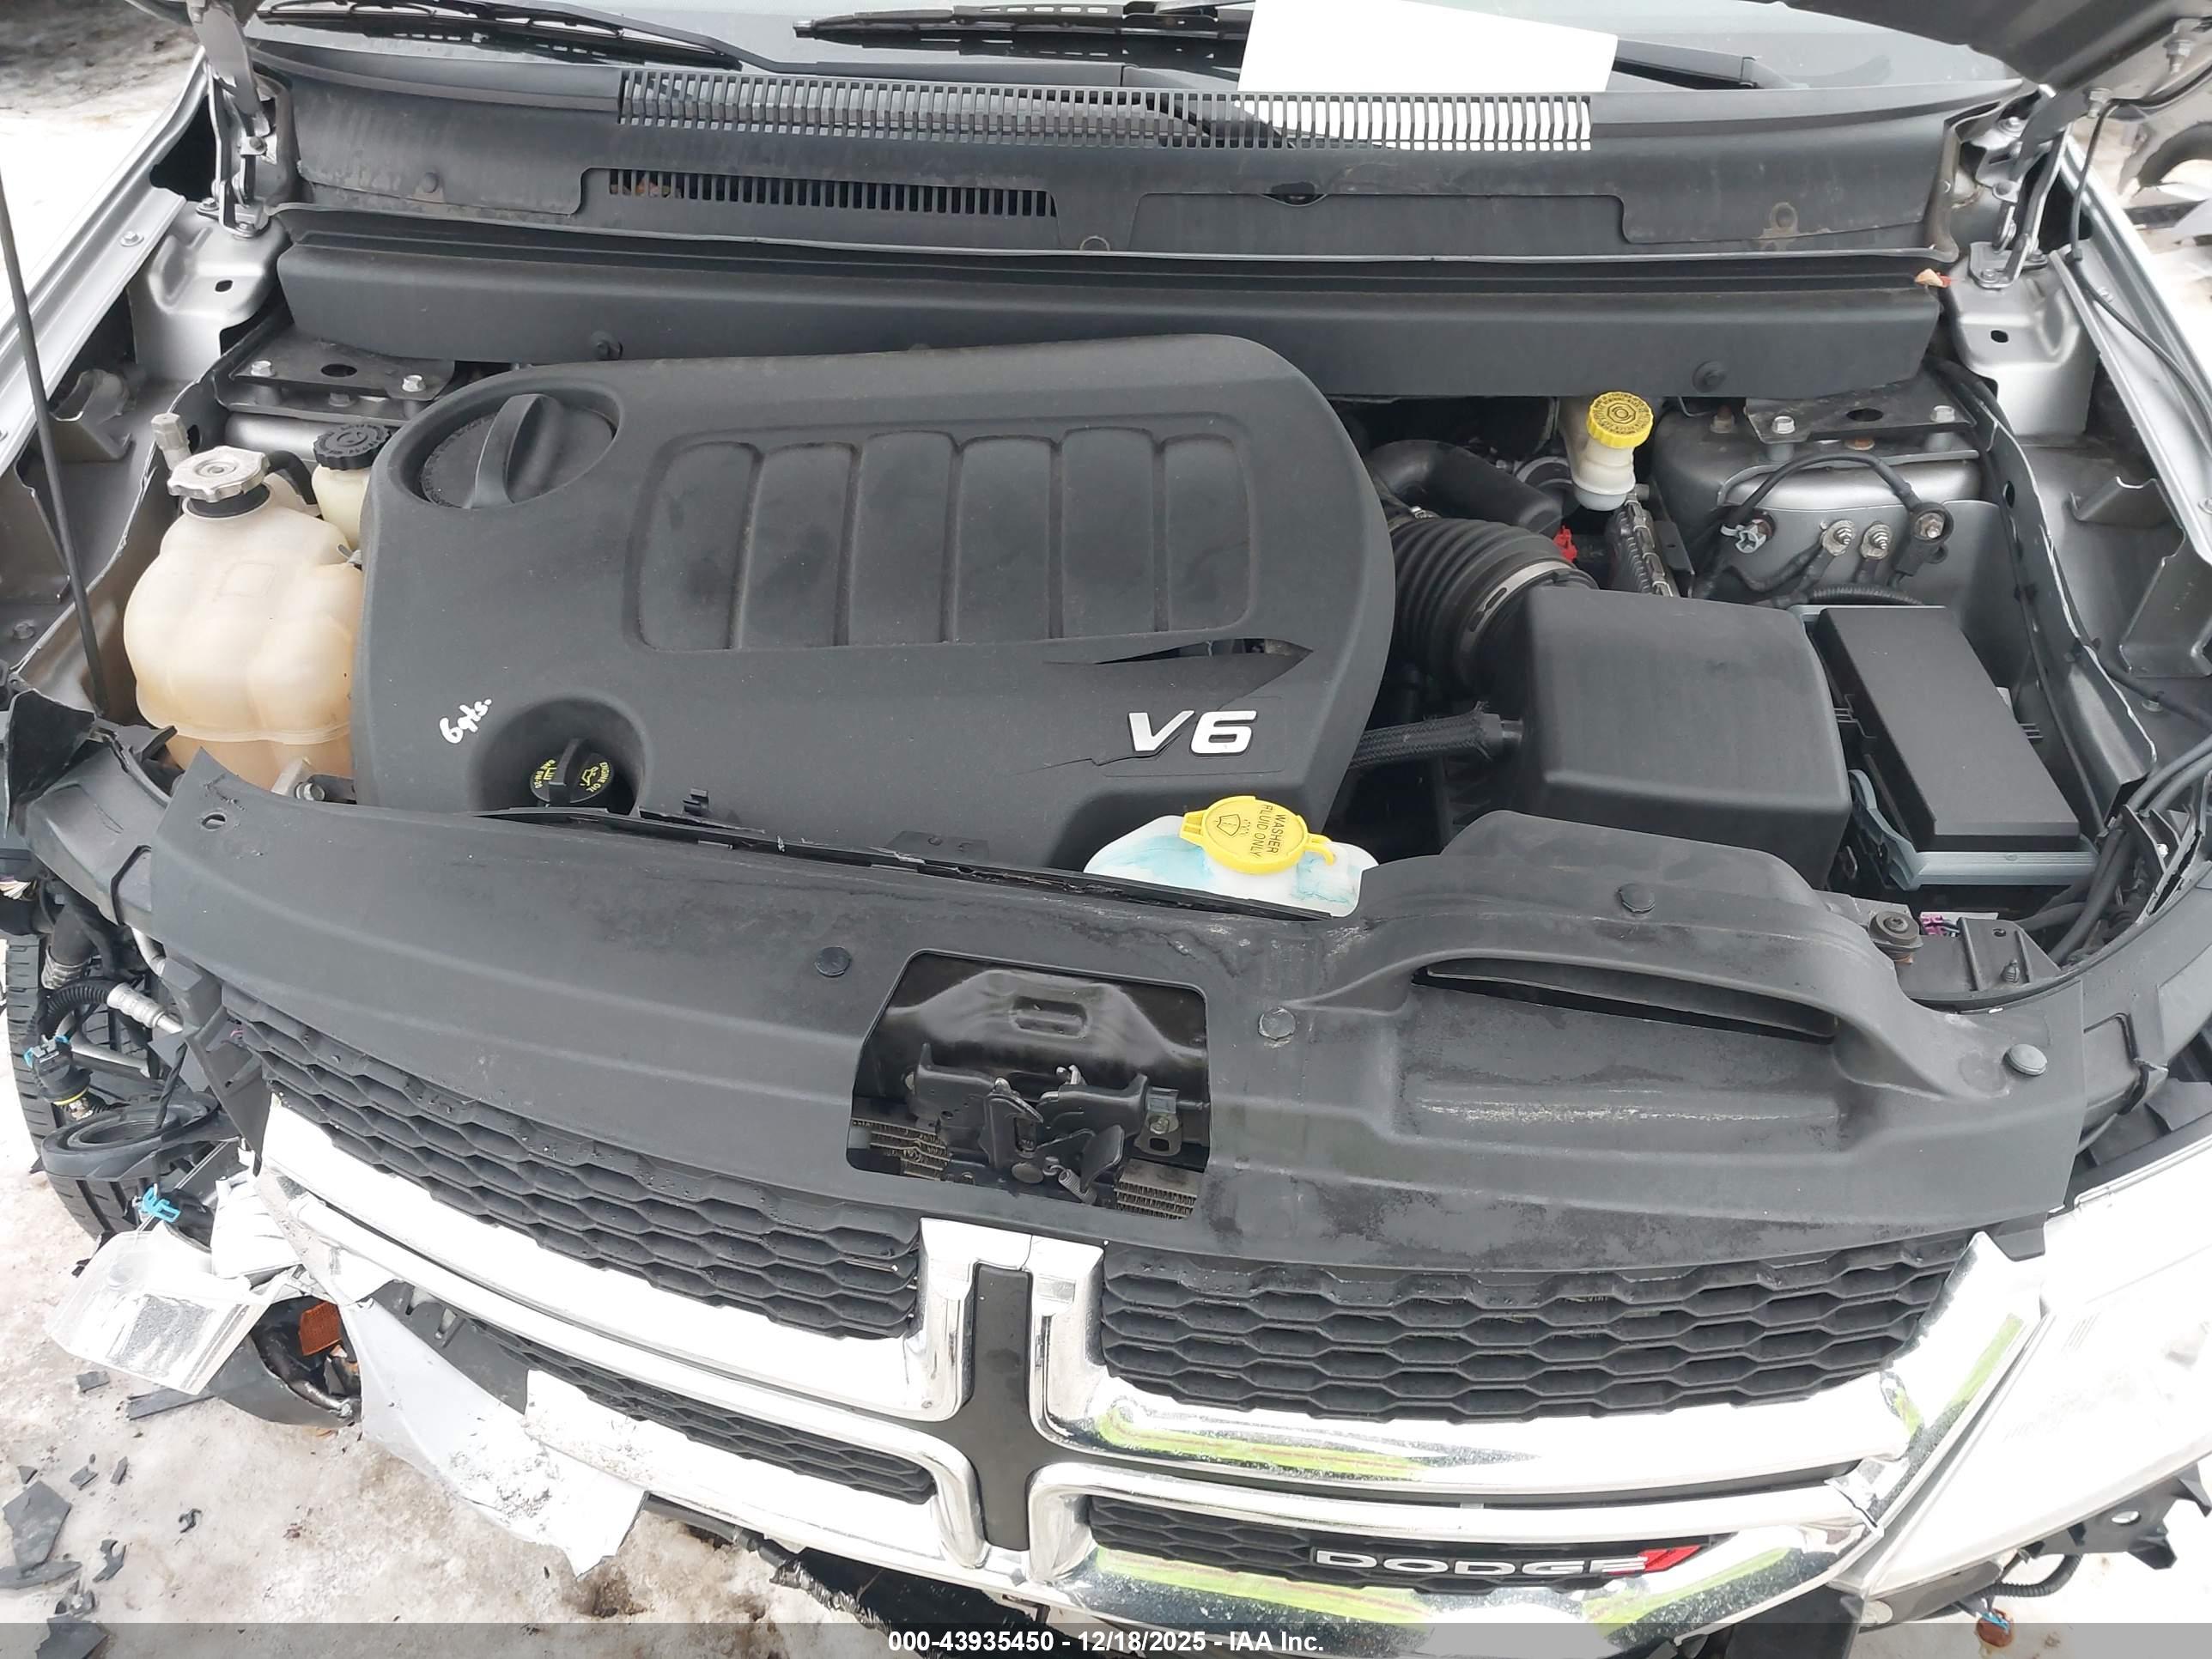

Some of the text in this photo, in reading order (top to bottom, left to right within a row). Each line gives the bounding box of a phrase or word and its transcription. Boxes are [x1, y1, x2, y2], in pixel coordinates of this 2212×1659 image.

[1128, 709, 1257, 755] V6
[586, 762, 610, 793] ENGINE OIL
[1249, 804, 1273, 858] FLUID ONLY
[1266, 813, 1287, 854] WASHER
[1316, 1548, 1648, 1576] DODGE
